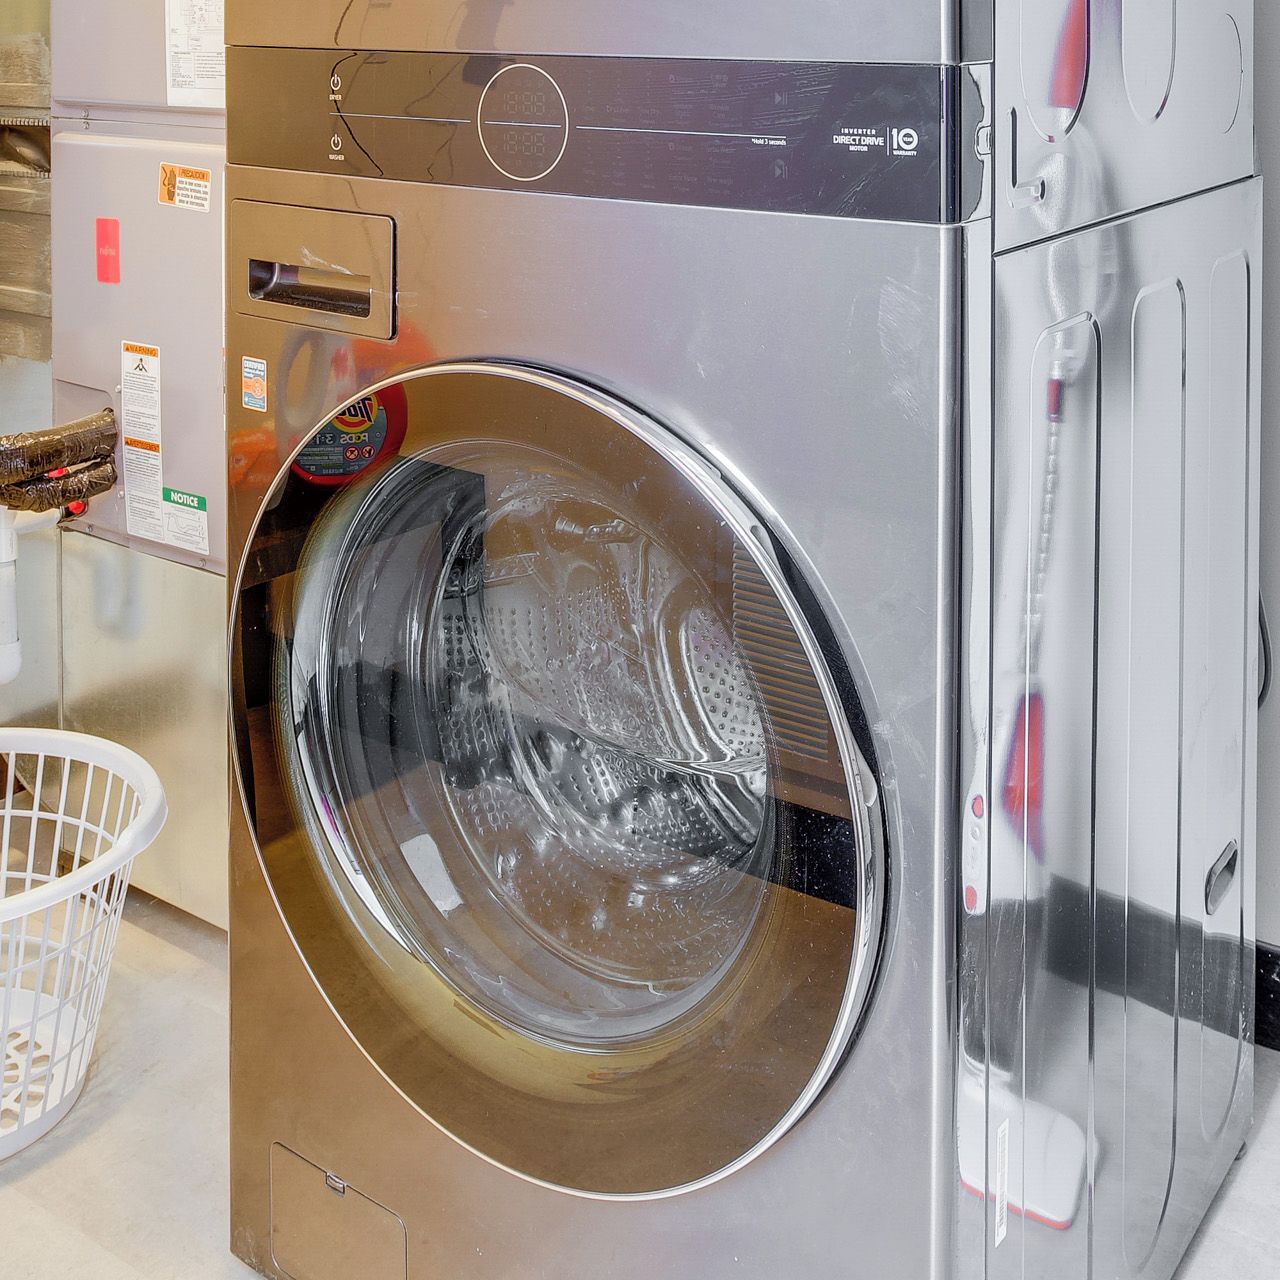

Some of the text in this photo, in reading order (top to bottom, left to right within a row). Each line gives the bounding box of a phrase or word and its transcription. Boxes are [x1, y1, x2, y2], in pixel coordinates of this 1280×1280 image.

[841, 127, 876, 135] INVERTER
[833, 135, 885, 146] DIRECT DRIVE
[891, 127, 919, 151] 10
[170, 491, 199, 507] NOTICE
